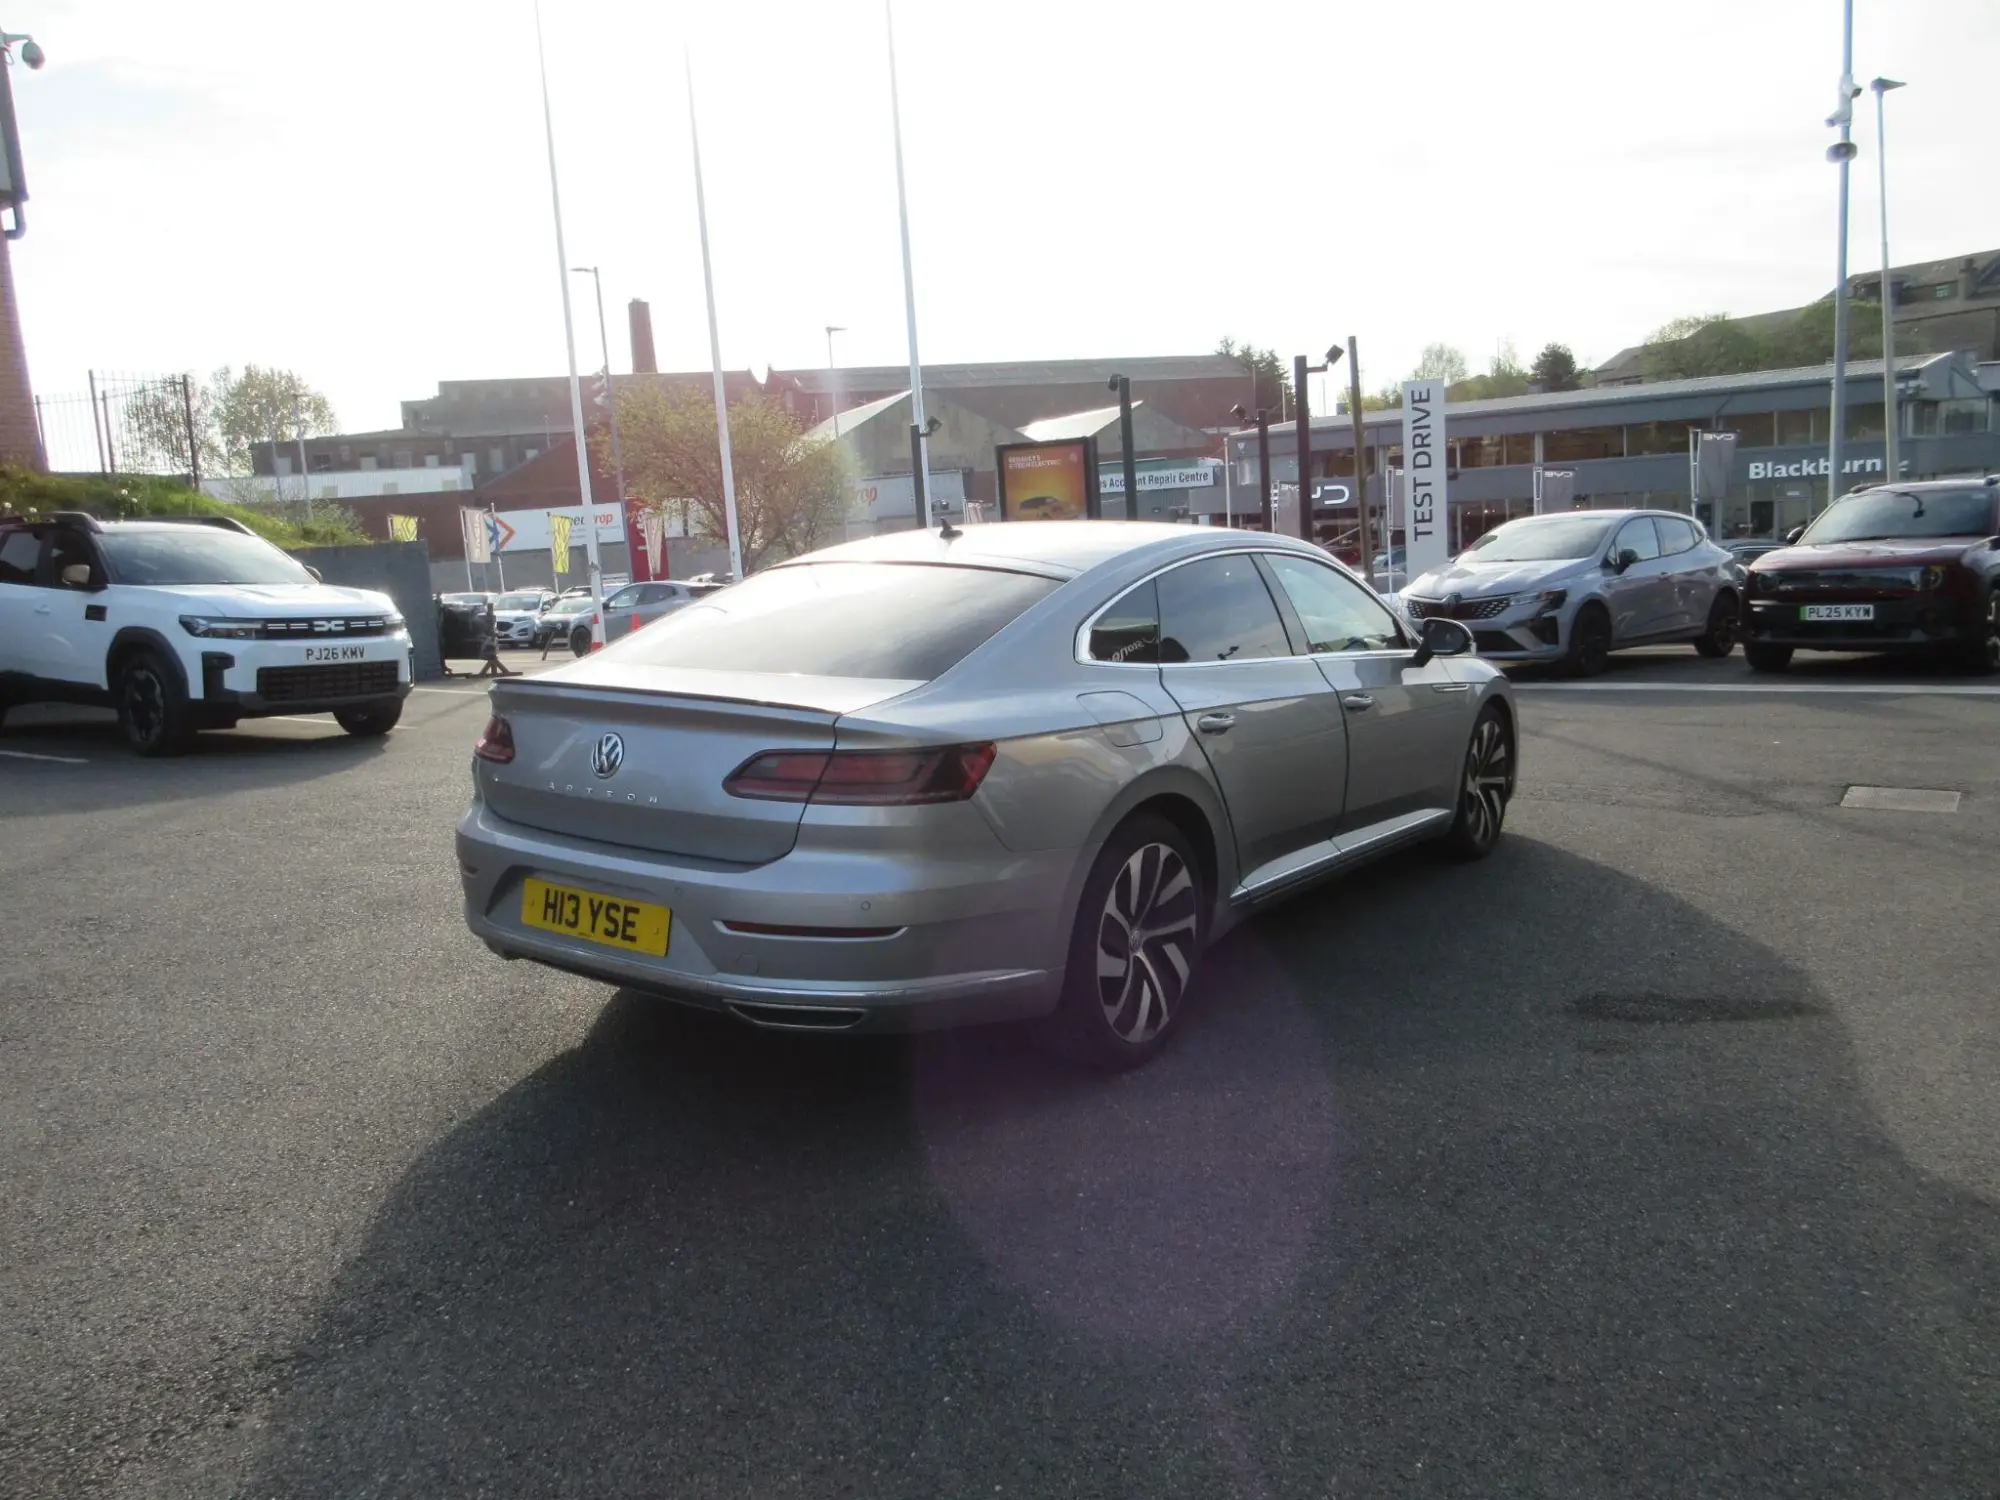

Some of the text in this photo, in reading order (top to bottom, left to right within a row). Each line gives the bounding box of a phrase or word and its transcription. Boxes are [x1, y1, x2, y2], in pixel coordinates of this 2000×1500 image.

[1411, 387, 1434, 542] TEST DRIVE
[1109, 476, 1146, 488] Accnt
[1148, 473, 1176, 487] Repair
[1179, 471, 1209, 483] Centre
[1807, 606, 1841, 618] PL25
[305, 644, 365, 660] PJ26 KMV
[548, 781, 658, 804] ARTEON
[543, 887, 640, 942] H13 YSE
